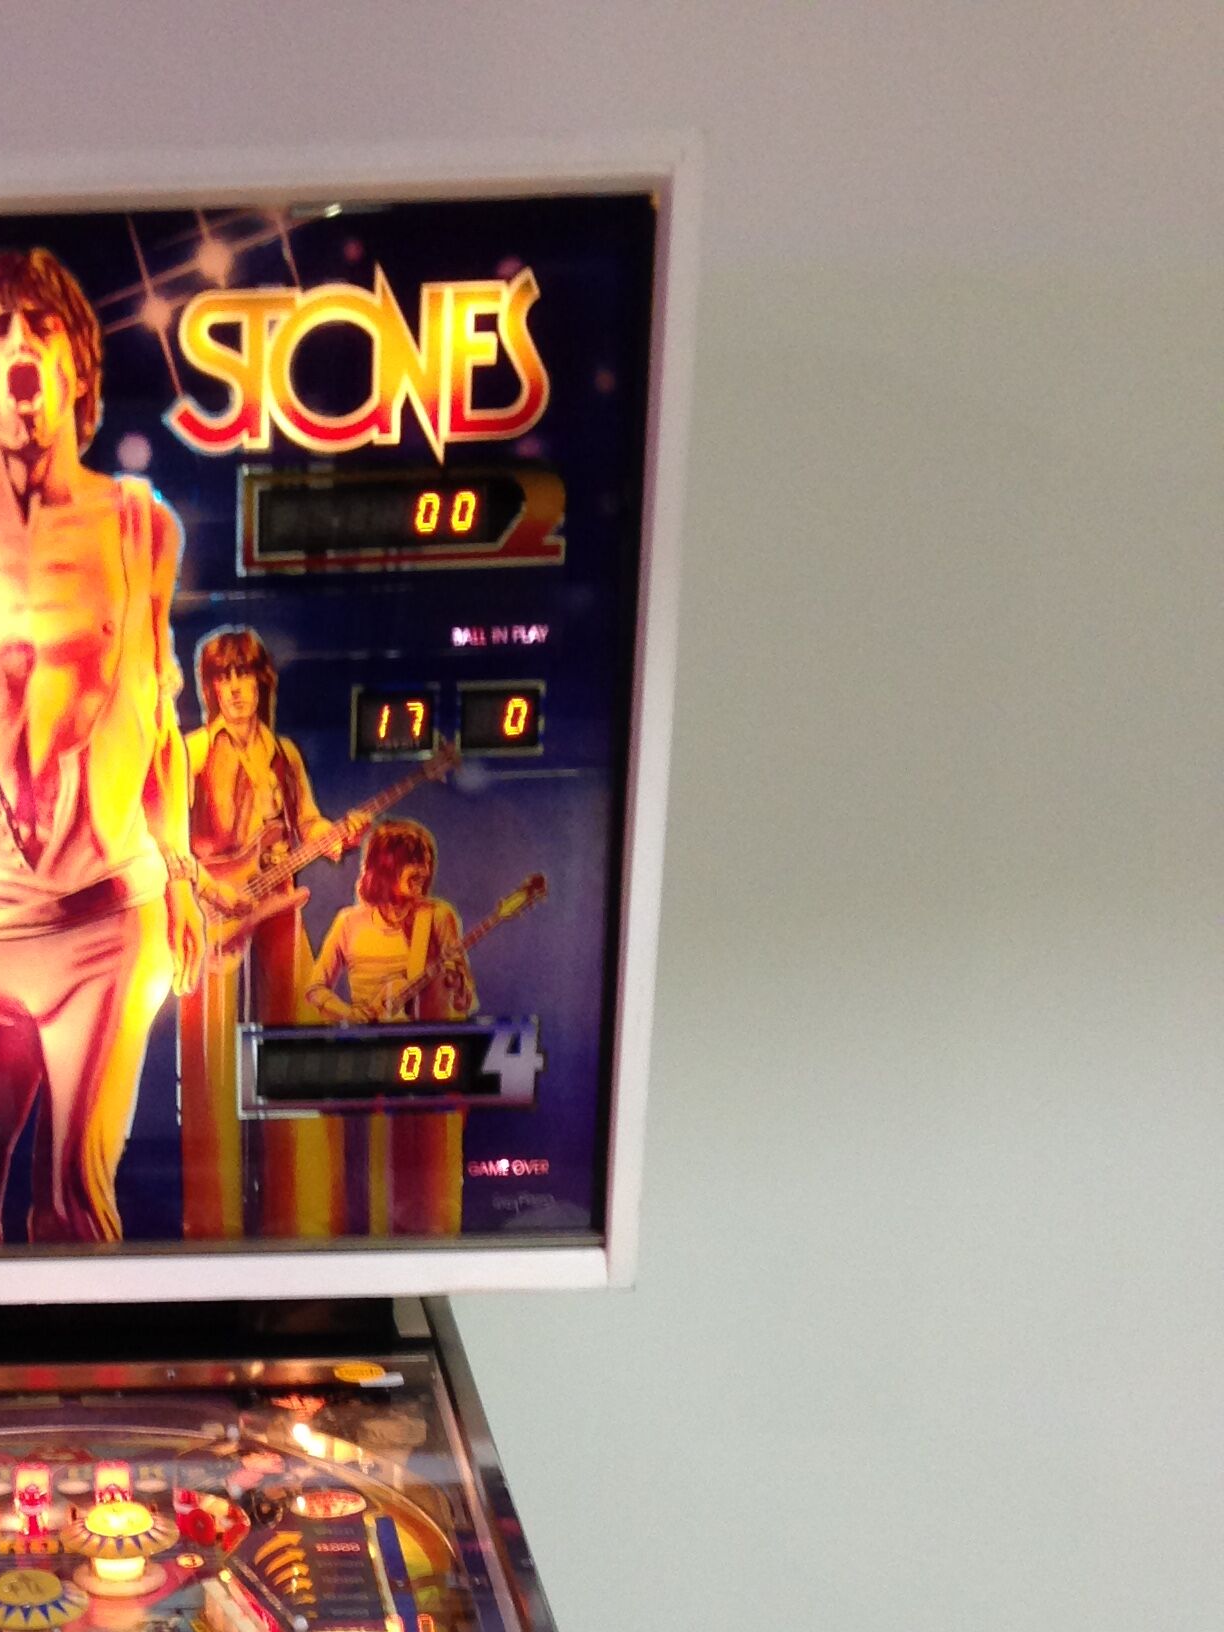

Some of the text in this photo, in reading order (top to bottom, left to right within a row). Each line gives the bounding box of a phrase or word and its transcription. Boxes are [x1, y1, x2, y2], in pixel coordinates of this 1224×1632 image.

[161, 262, 551, 465] STONES
[451, 623, 549, 646] BALL IN PLAY
[504, 698, 528, 736] 0
[467, 1159, 549, 1177] GAME OVER
